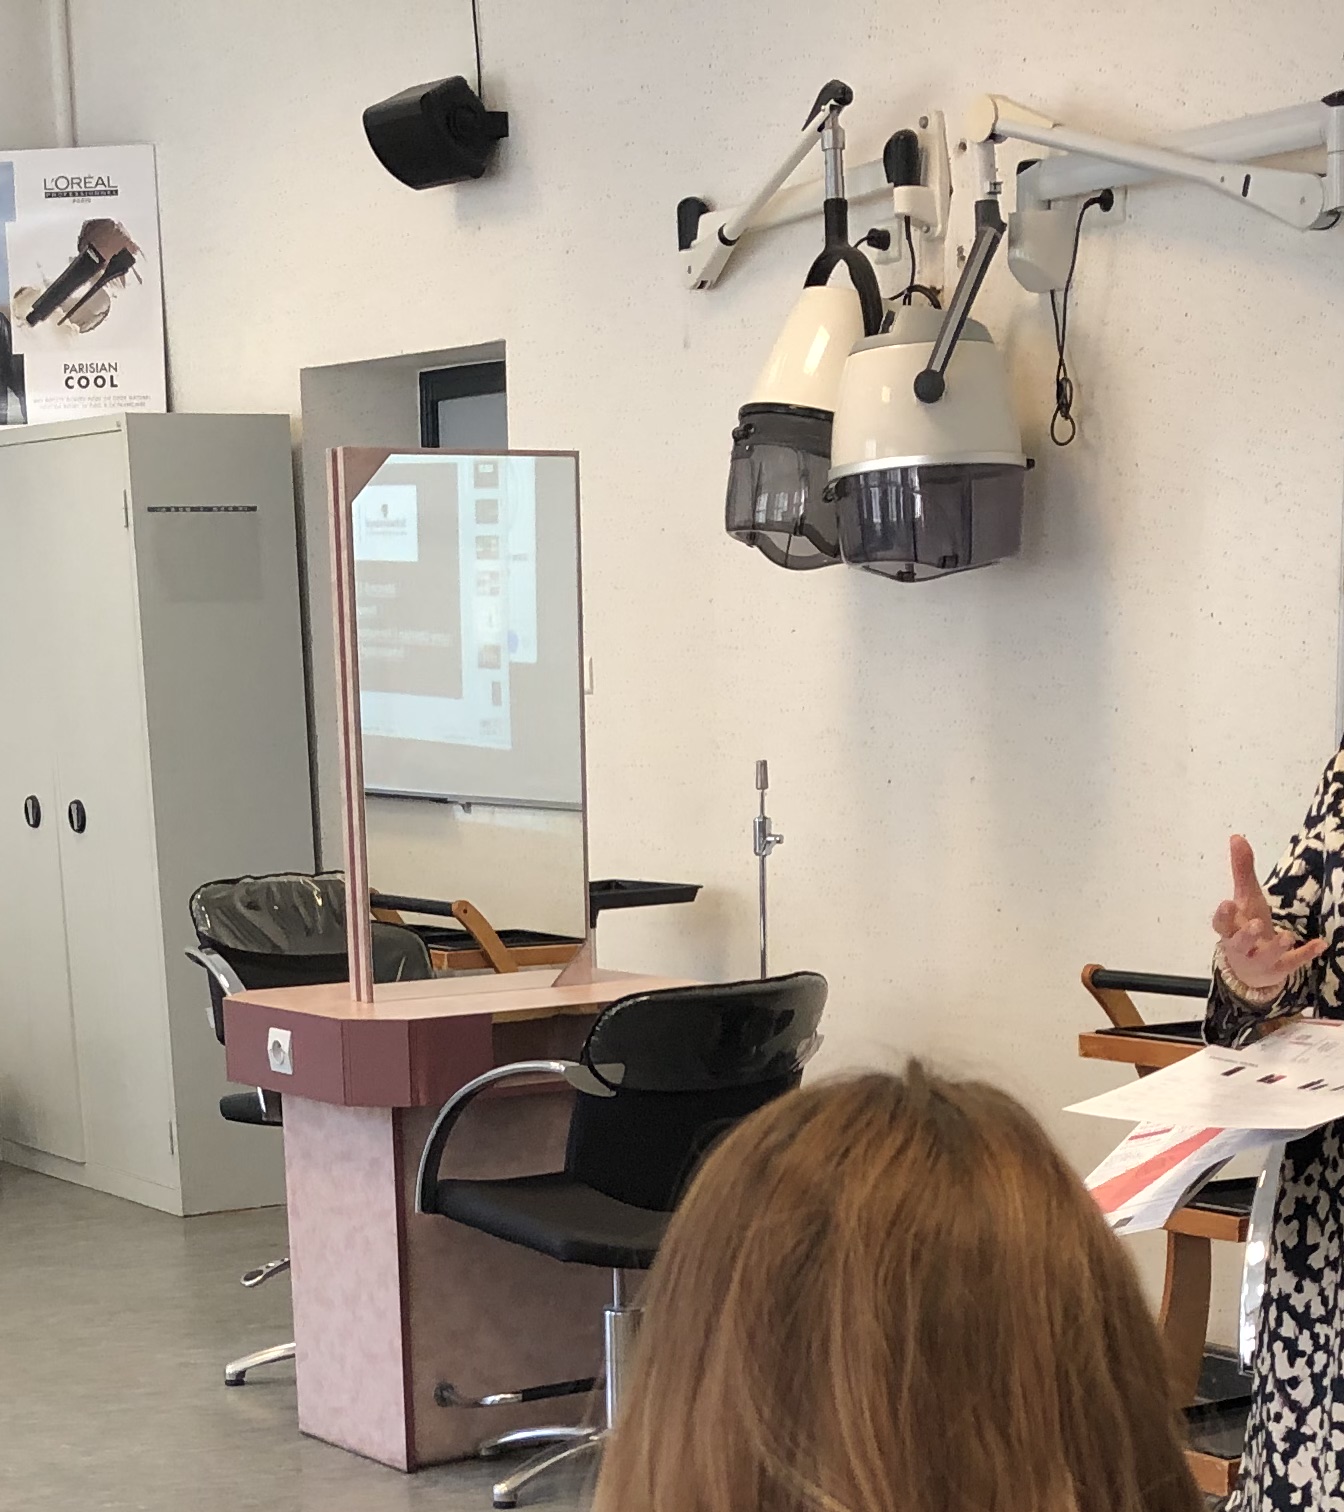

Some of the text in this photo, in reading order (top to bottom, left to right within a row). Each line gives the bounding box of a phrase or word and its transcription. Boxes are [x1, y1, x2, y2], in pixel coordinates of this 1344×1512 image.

[43, 174, 118, 191] L'ORÉAL
[63, 362, 118, 374] PARISIAN
[64, 374, 119, 389] COOL
